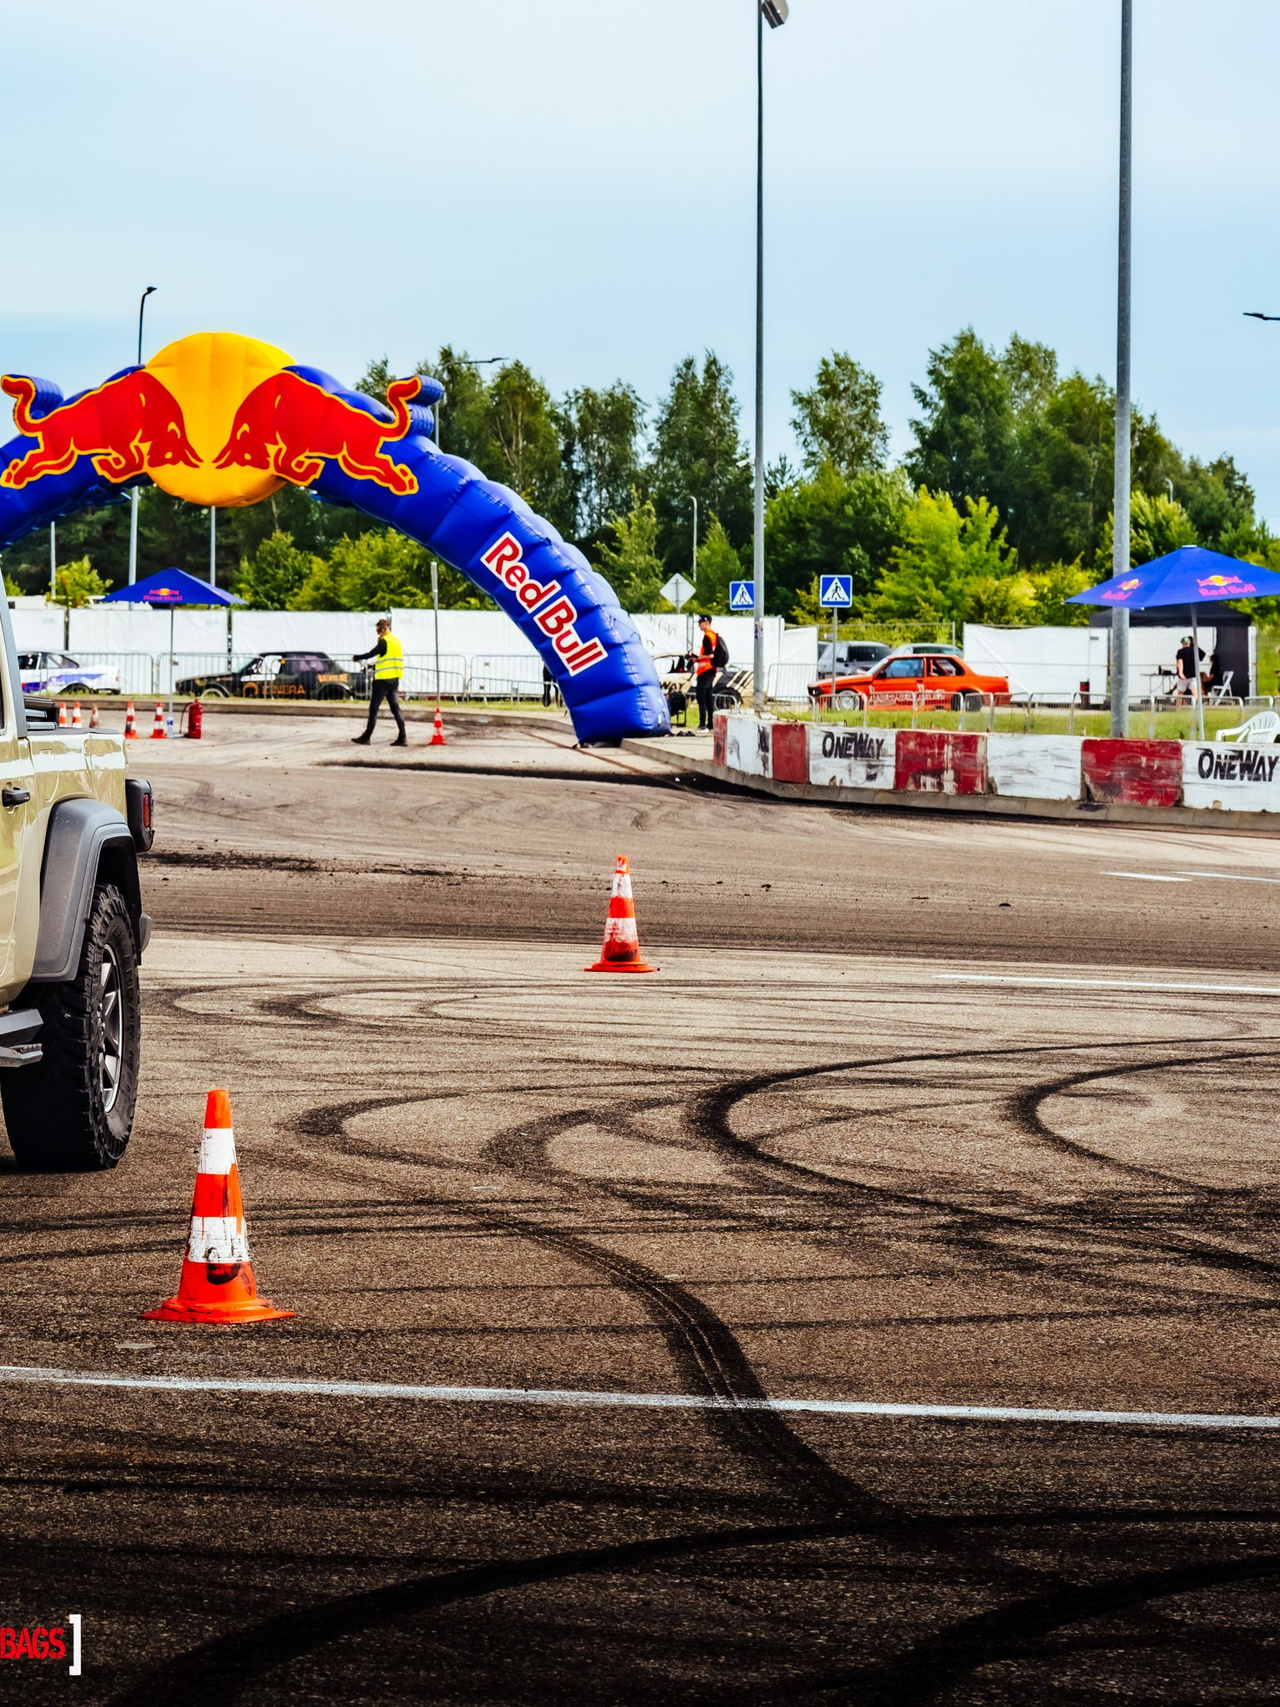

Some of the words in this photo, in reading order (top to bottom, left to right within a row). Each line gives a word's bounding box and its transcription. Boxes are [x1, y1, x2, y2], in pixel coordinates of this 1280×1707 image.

[483, 535, 559, 611] Red
[536, 598, 605, 673] Bull
[1198, 585, 1229, 597] Red
[1227, 583, 1257, 594] Bull
